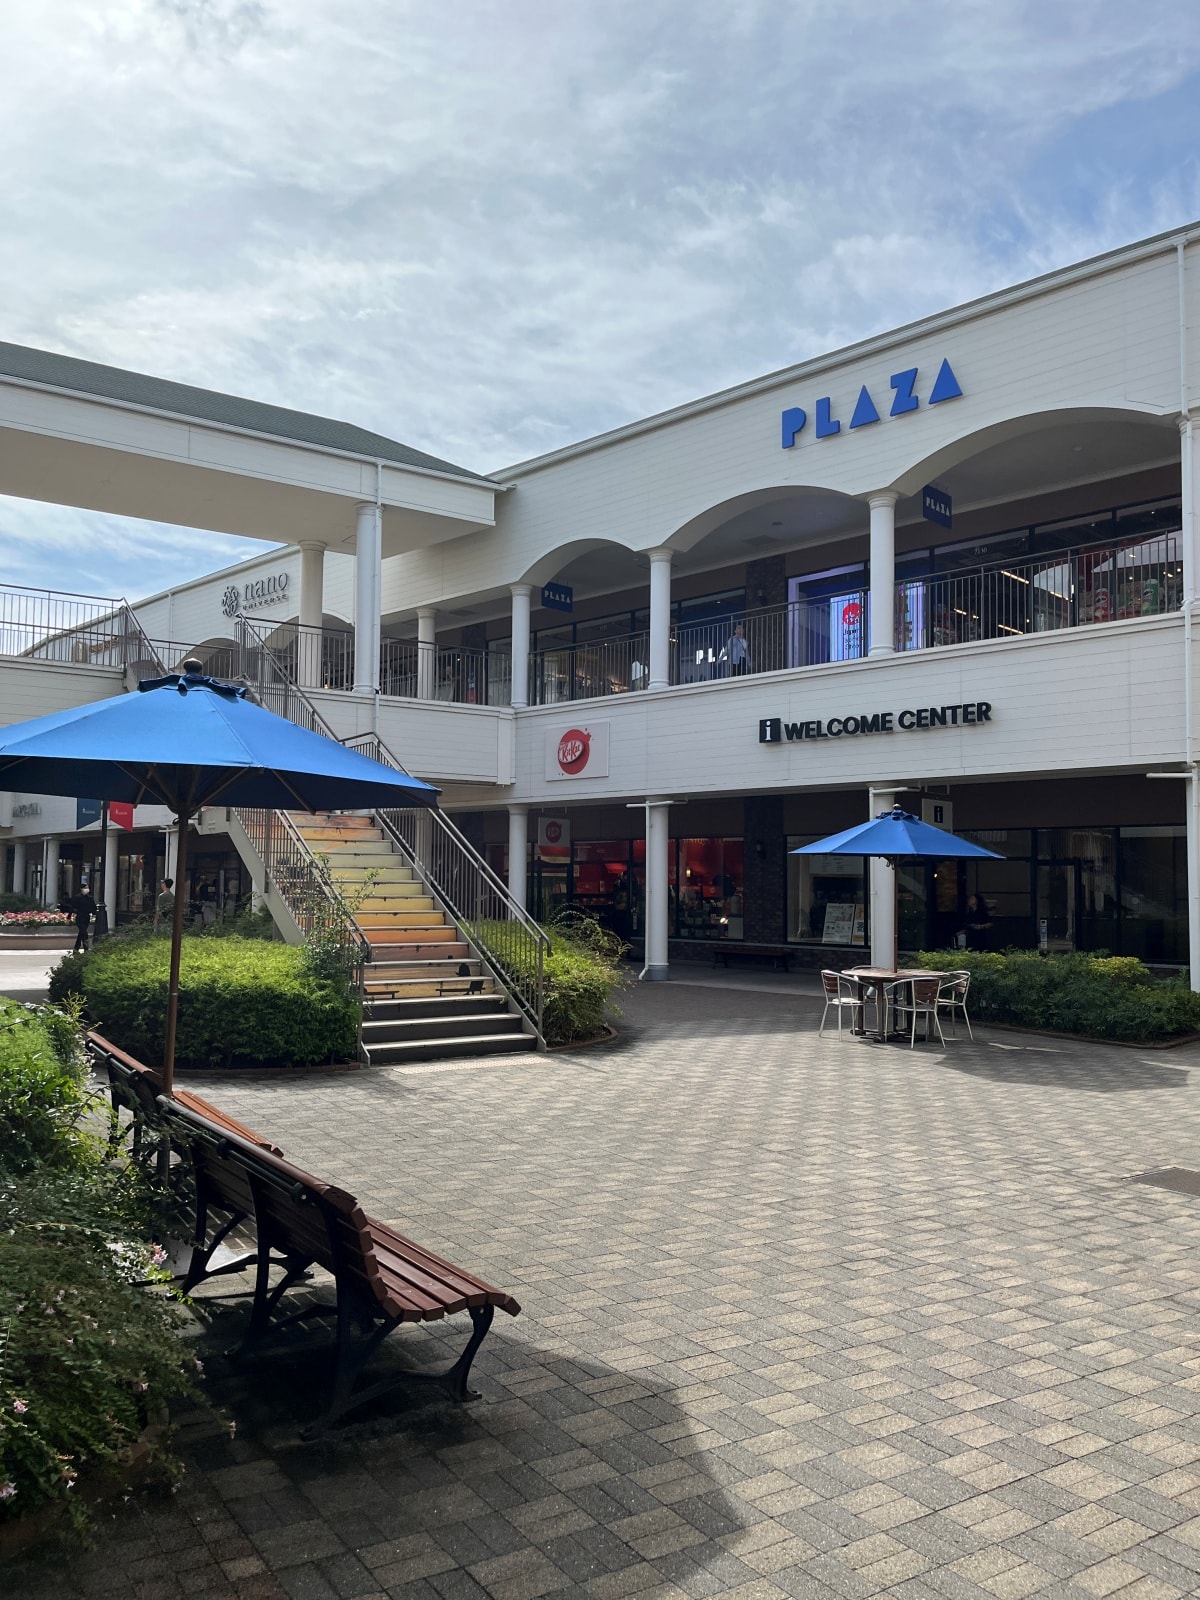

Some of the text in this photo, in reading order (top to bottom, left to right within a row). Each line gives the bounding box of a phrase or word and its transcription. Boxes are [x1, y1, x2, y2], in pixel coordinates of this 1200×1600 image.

[782, 357, 963, 449] PLAZA
[926, 496, 950, 517] PLAZA
[244, 573, 288, 601] nano
[544, 590, 571, 604] PLAZA
[784, 712, 894, 741] WELCOME
[898, 701, 992, 730] CENTER
